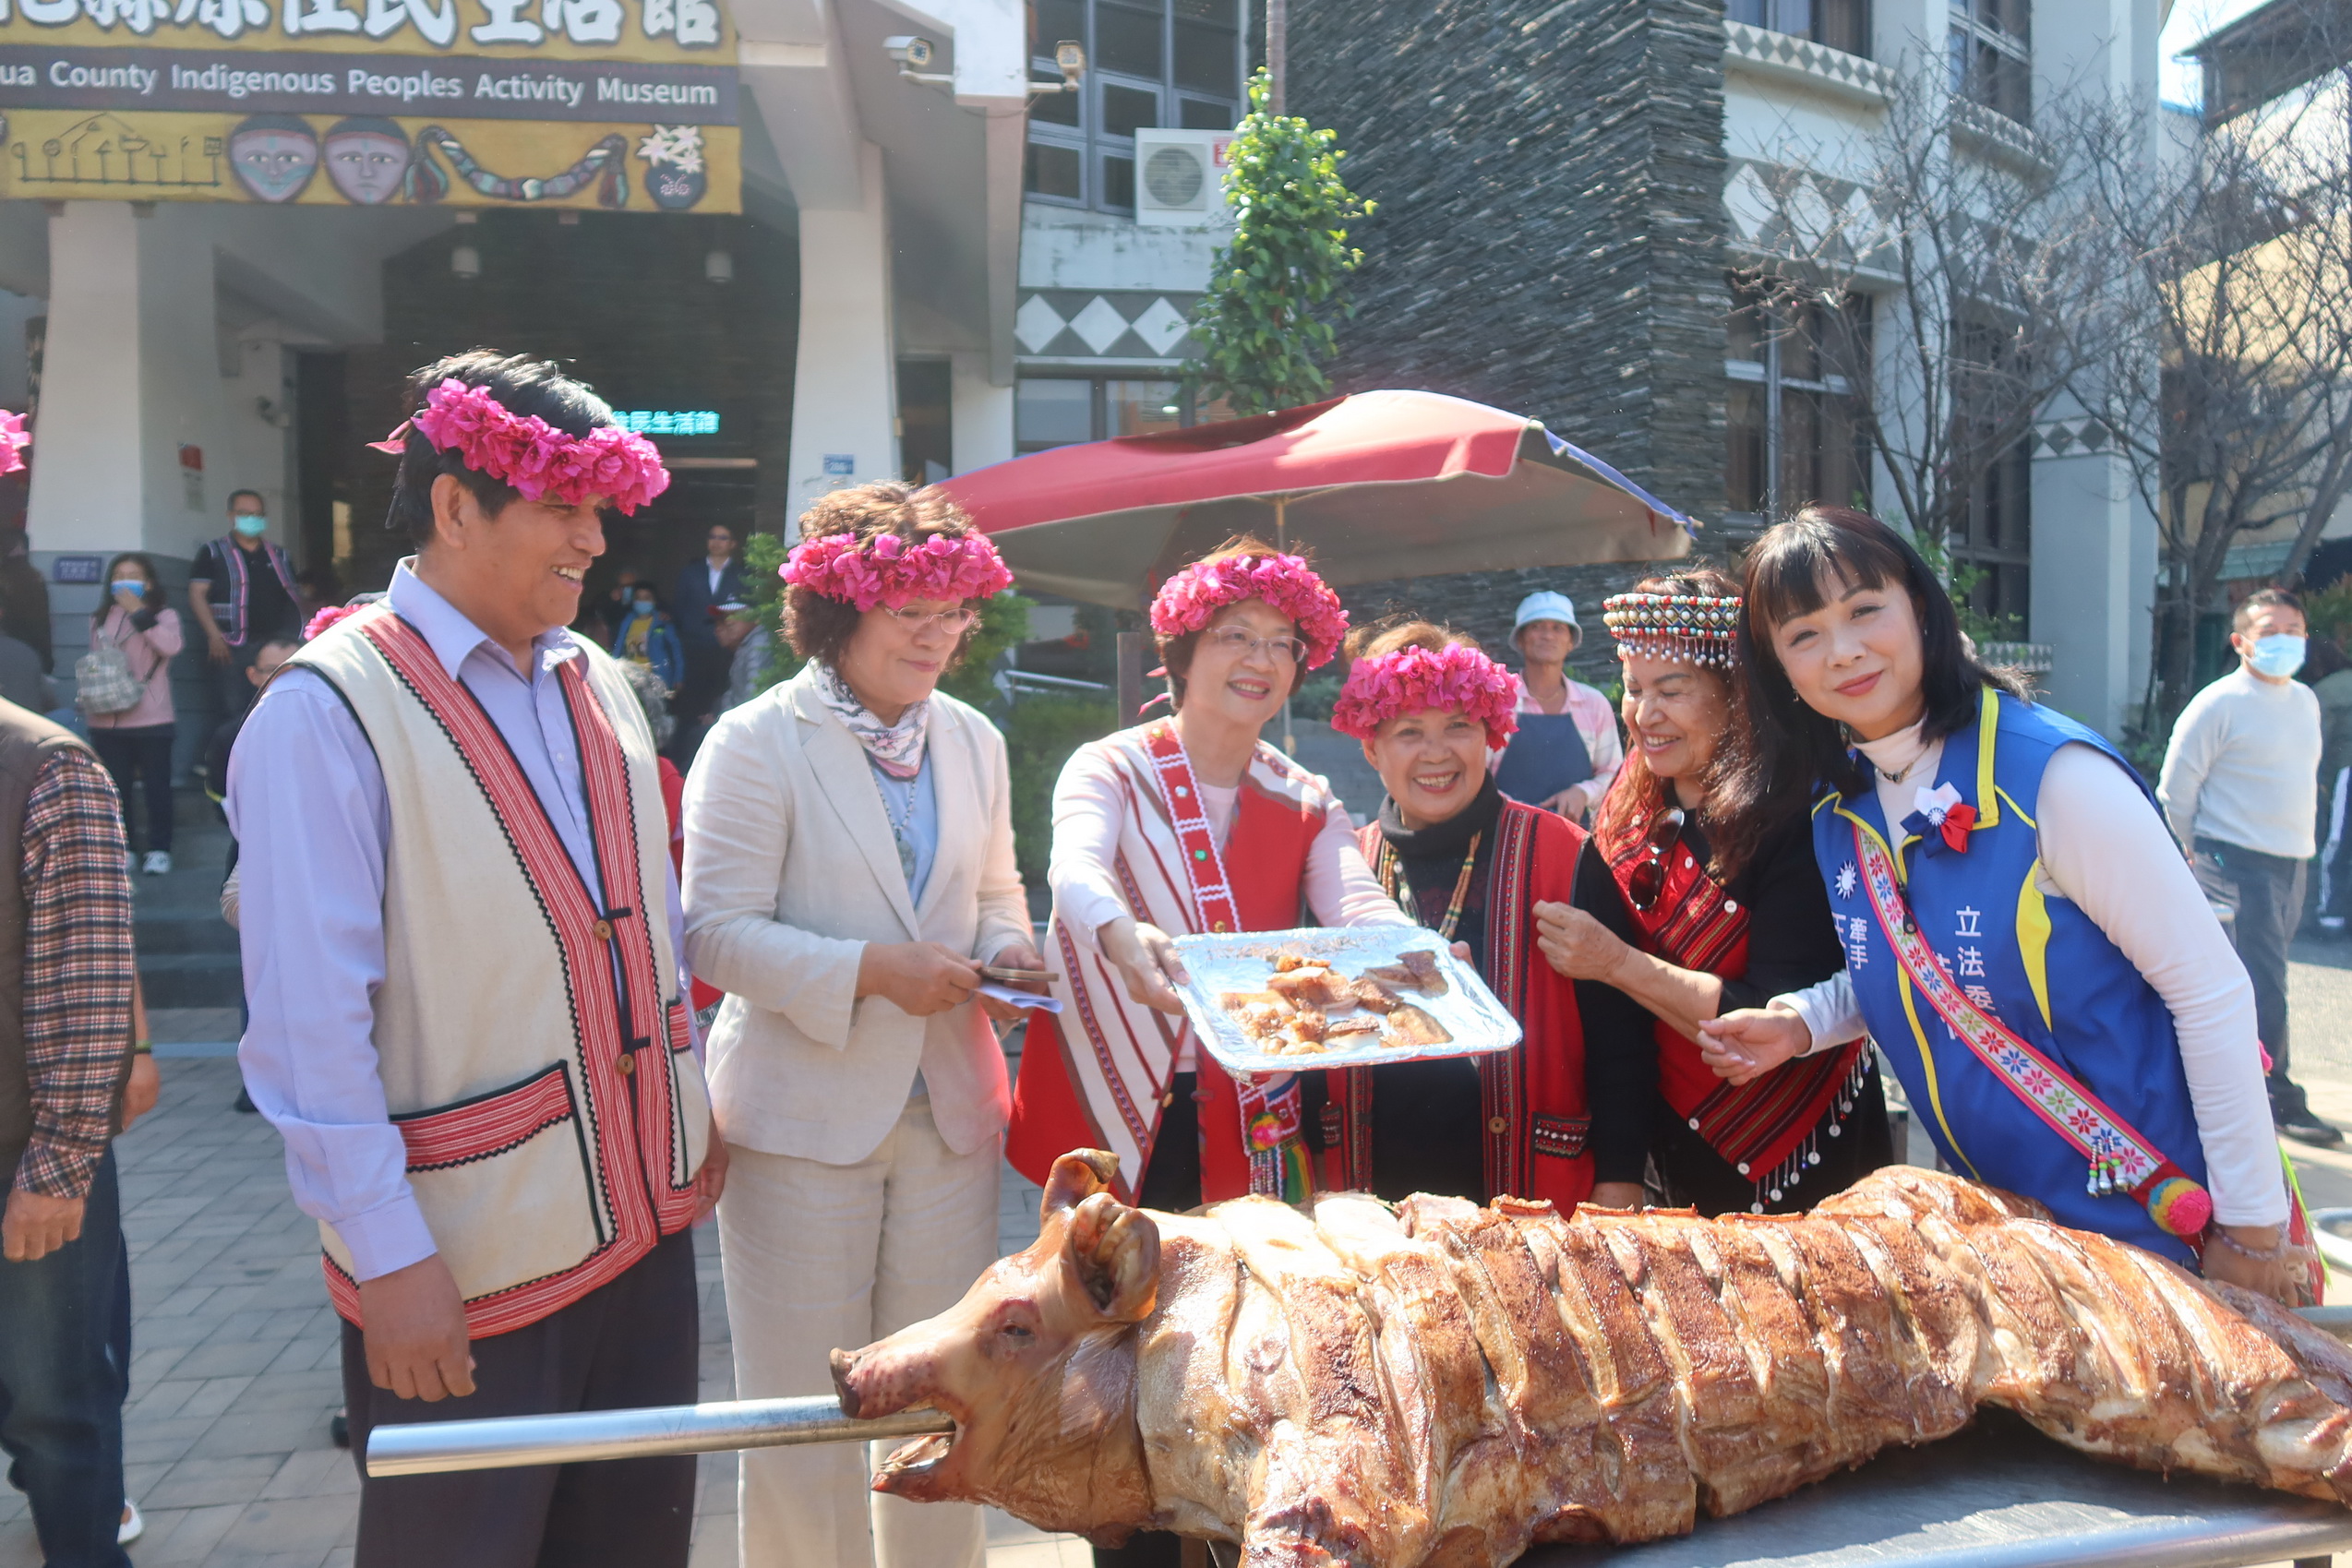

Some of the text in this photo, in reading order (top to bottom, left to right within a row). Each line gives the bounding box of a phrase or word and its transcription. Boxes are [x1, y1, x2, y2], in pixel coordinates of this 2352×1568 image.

[49, 60, 158, 94] County
[172, 64, 335, 98] Indigenous
[348, 68, 463, 102] Peoples
[474, 73, 584, 107] Activity
[596, 77, 718, 106] Museum
[1849, 916, 1869, 971] 牽手
[1954, 904, 2006, 1026] 立法委
